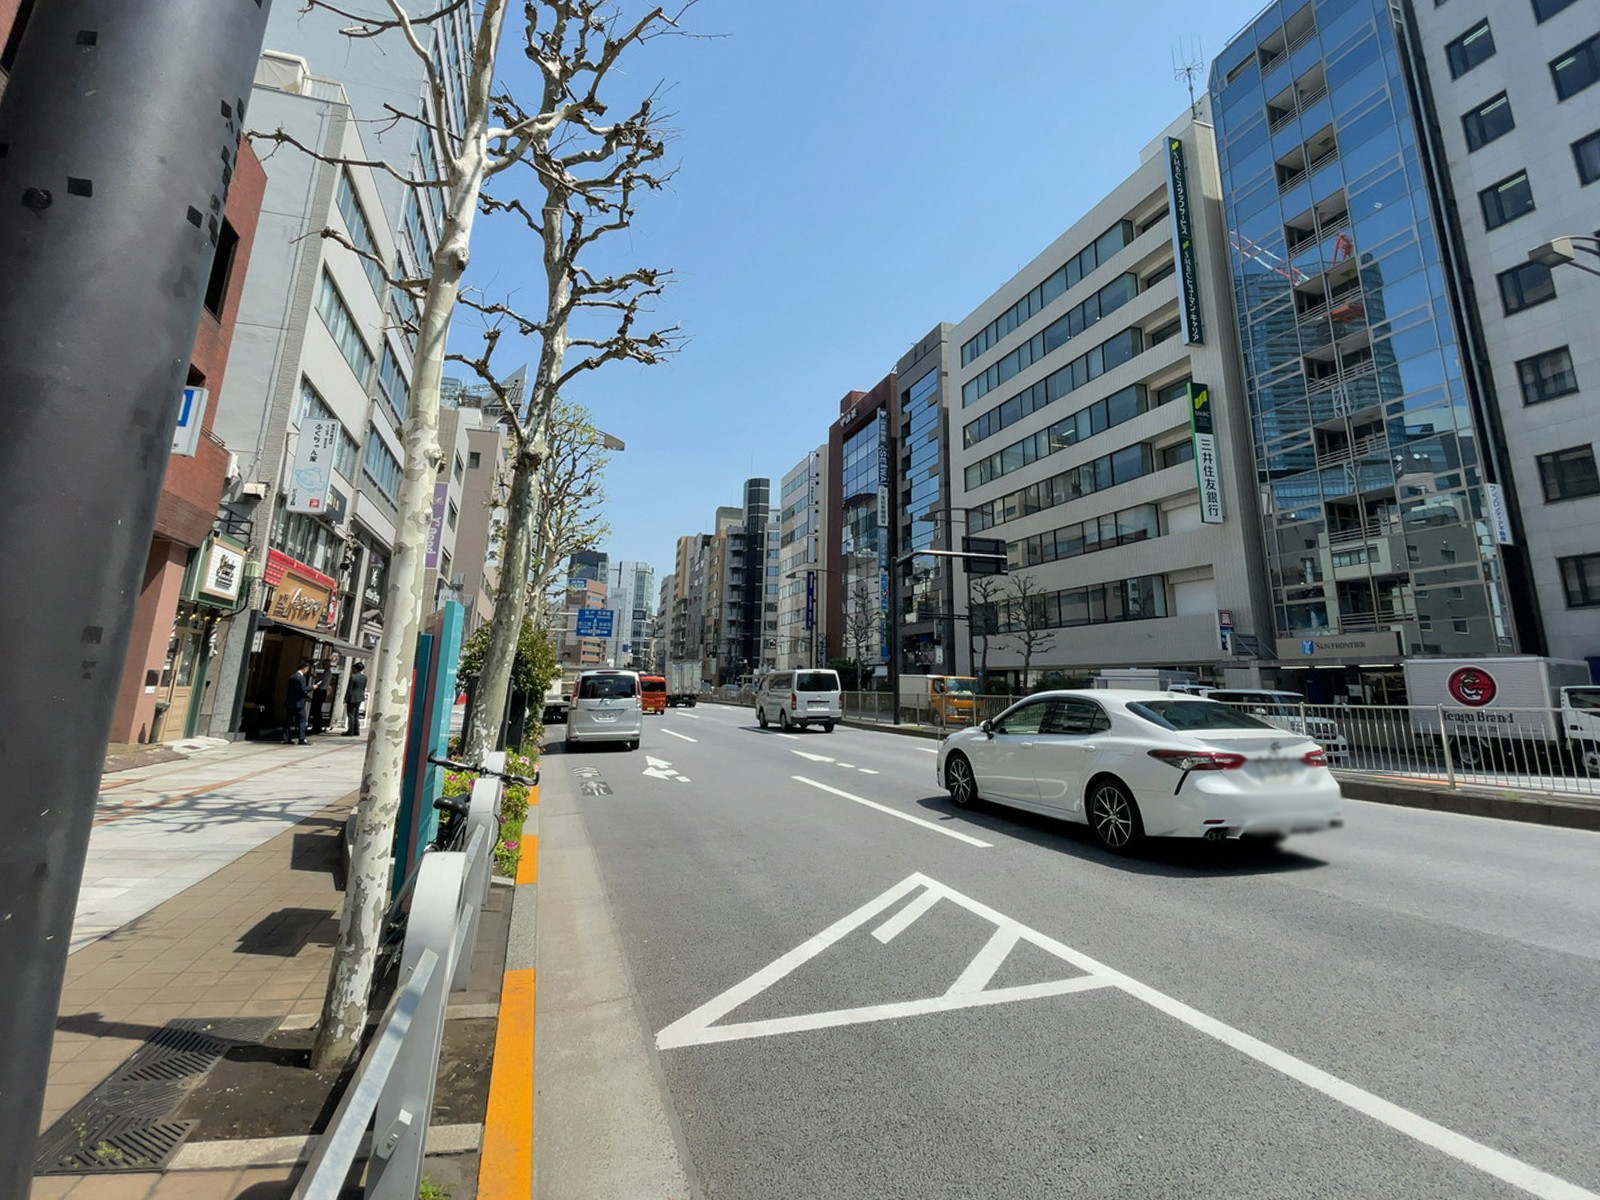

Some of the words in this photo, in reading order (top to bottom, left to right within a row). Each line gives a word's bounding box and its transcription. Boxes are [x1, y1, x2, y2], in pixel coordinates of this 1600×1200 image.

[1200, 438, 1219, 517] 三井住友銀行
